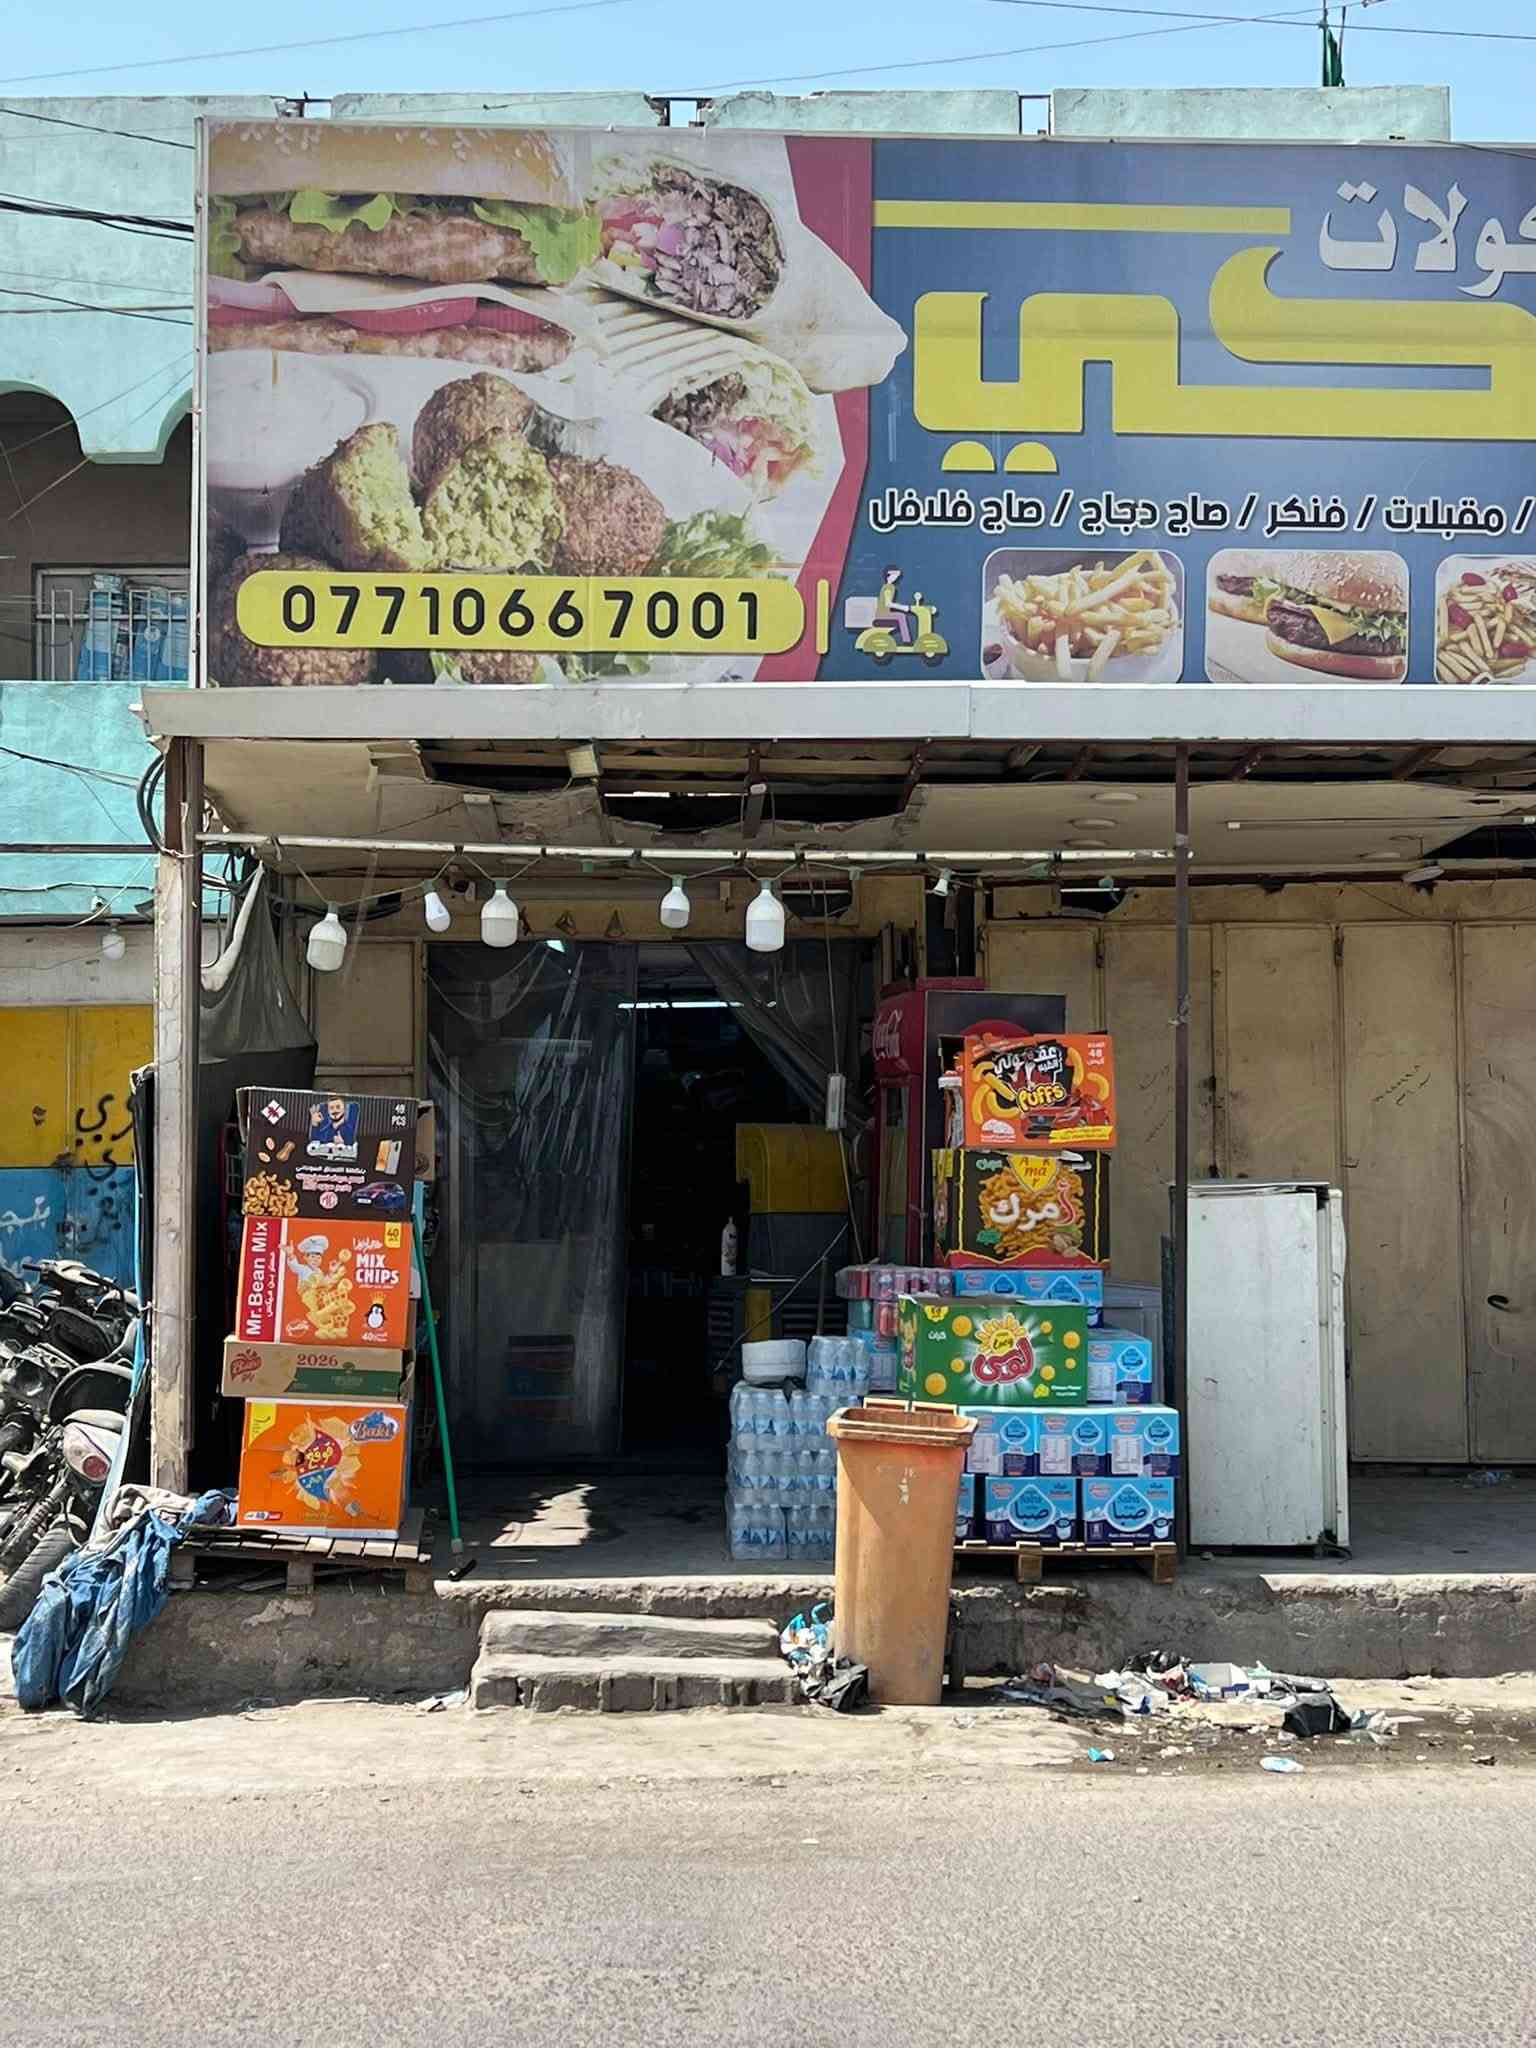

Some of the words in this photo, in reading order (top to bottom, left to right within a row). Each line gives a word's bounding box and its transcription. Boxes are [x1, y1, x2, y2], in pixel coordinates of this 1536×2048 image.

[871, 490, 974, 532] فلافل
[980, 490, 1044, 534] صاج
[1080, 492, 1159, 534] دجاج
[1166, 494, 1231, 535] صاج
[1265, 498, 1347, 538] فنكر
[1385, 497, 1506, 539] مقبلات
[282, 584, 759, 640] 07710667001
[251, 1221, 268, 1252] Mix
[355, 1268, 400, 1285] CHIPS
[356, 1253, 386, 1268] MIX
[297, 1354, 338, 1367] 2026
